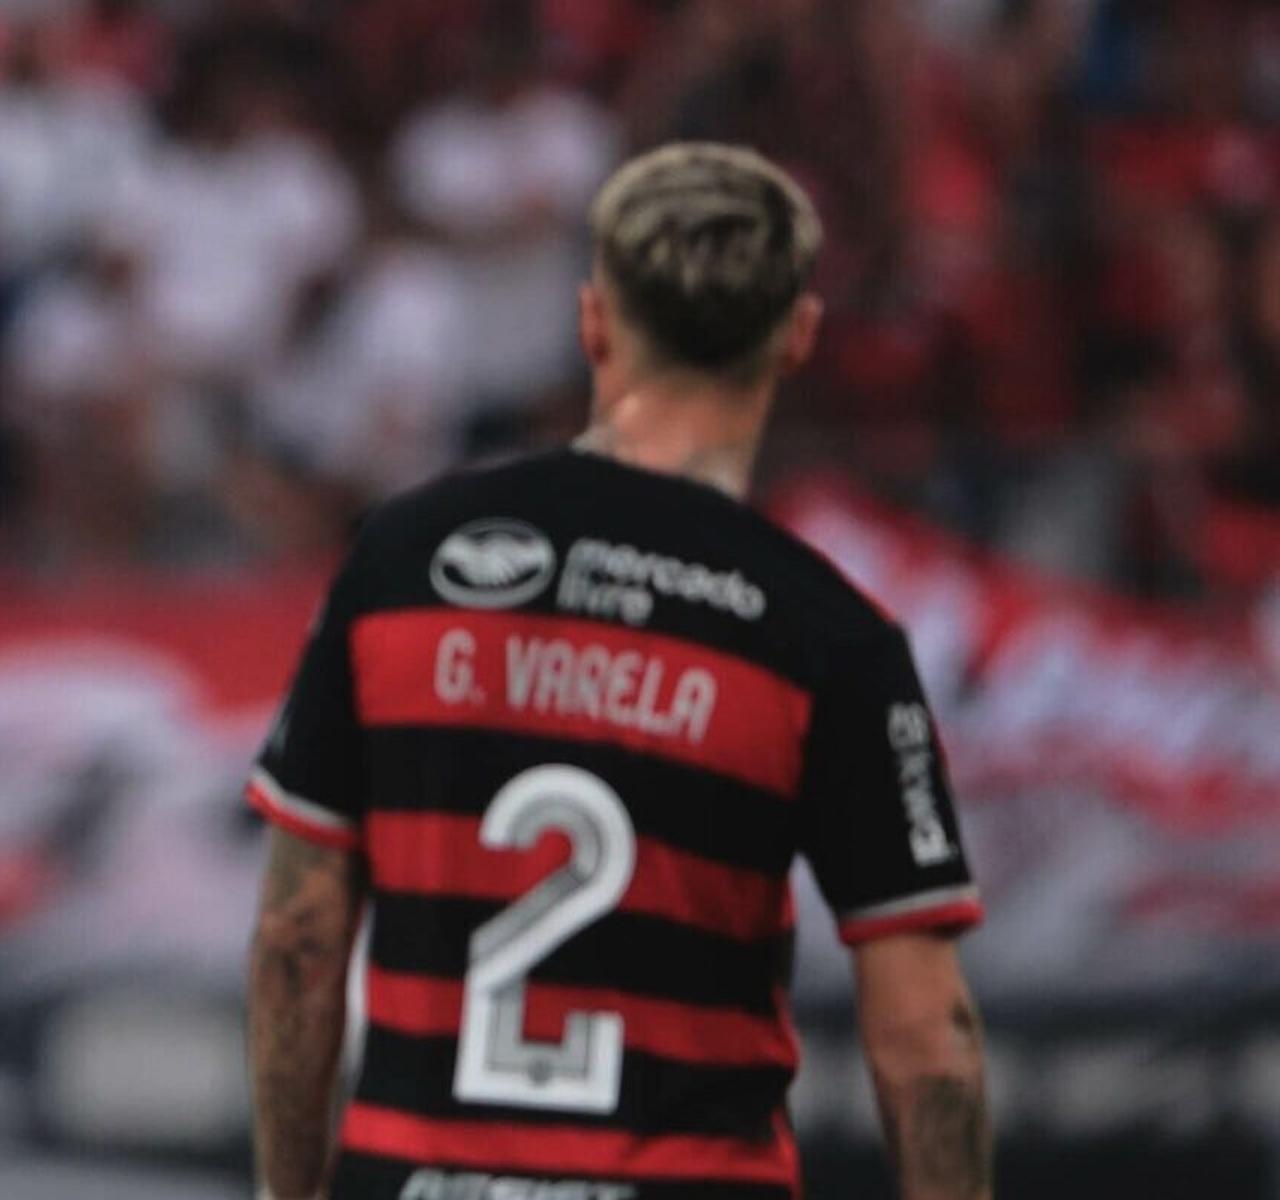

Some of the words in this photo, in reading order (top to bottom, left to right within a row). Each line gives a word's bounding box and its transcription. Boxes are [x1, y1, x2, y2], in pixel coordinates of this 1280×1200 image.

[434, 630, 486, 705] G.
[506, 633, 718, 744] VARELA
[452, 762, 638, 1114] 2
